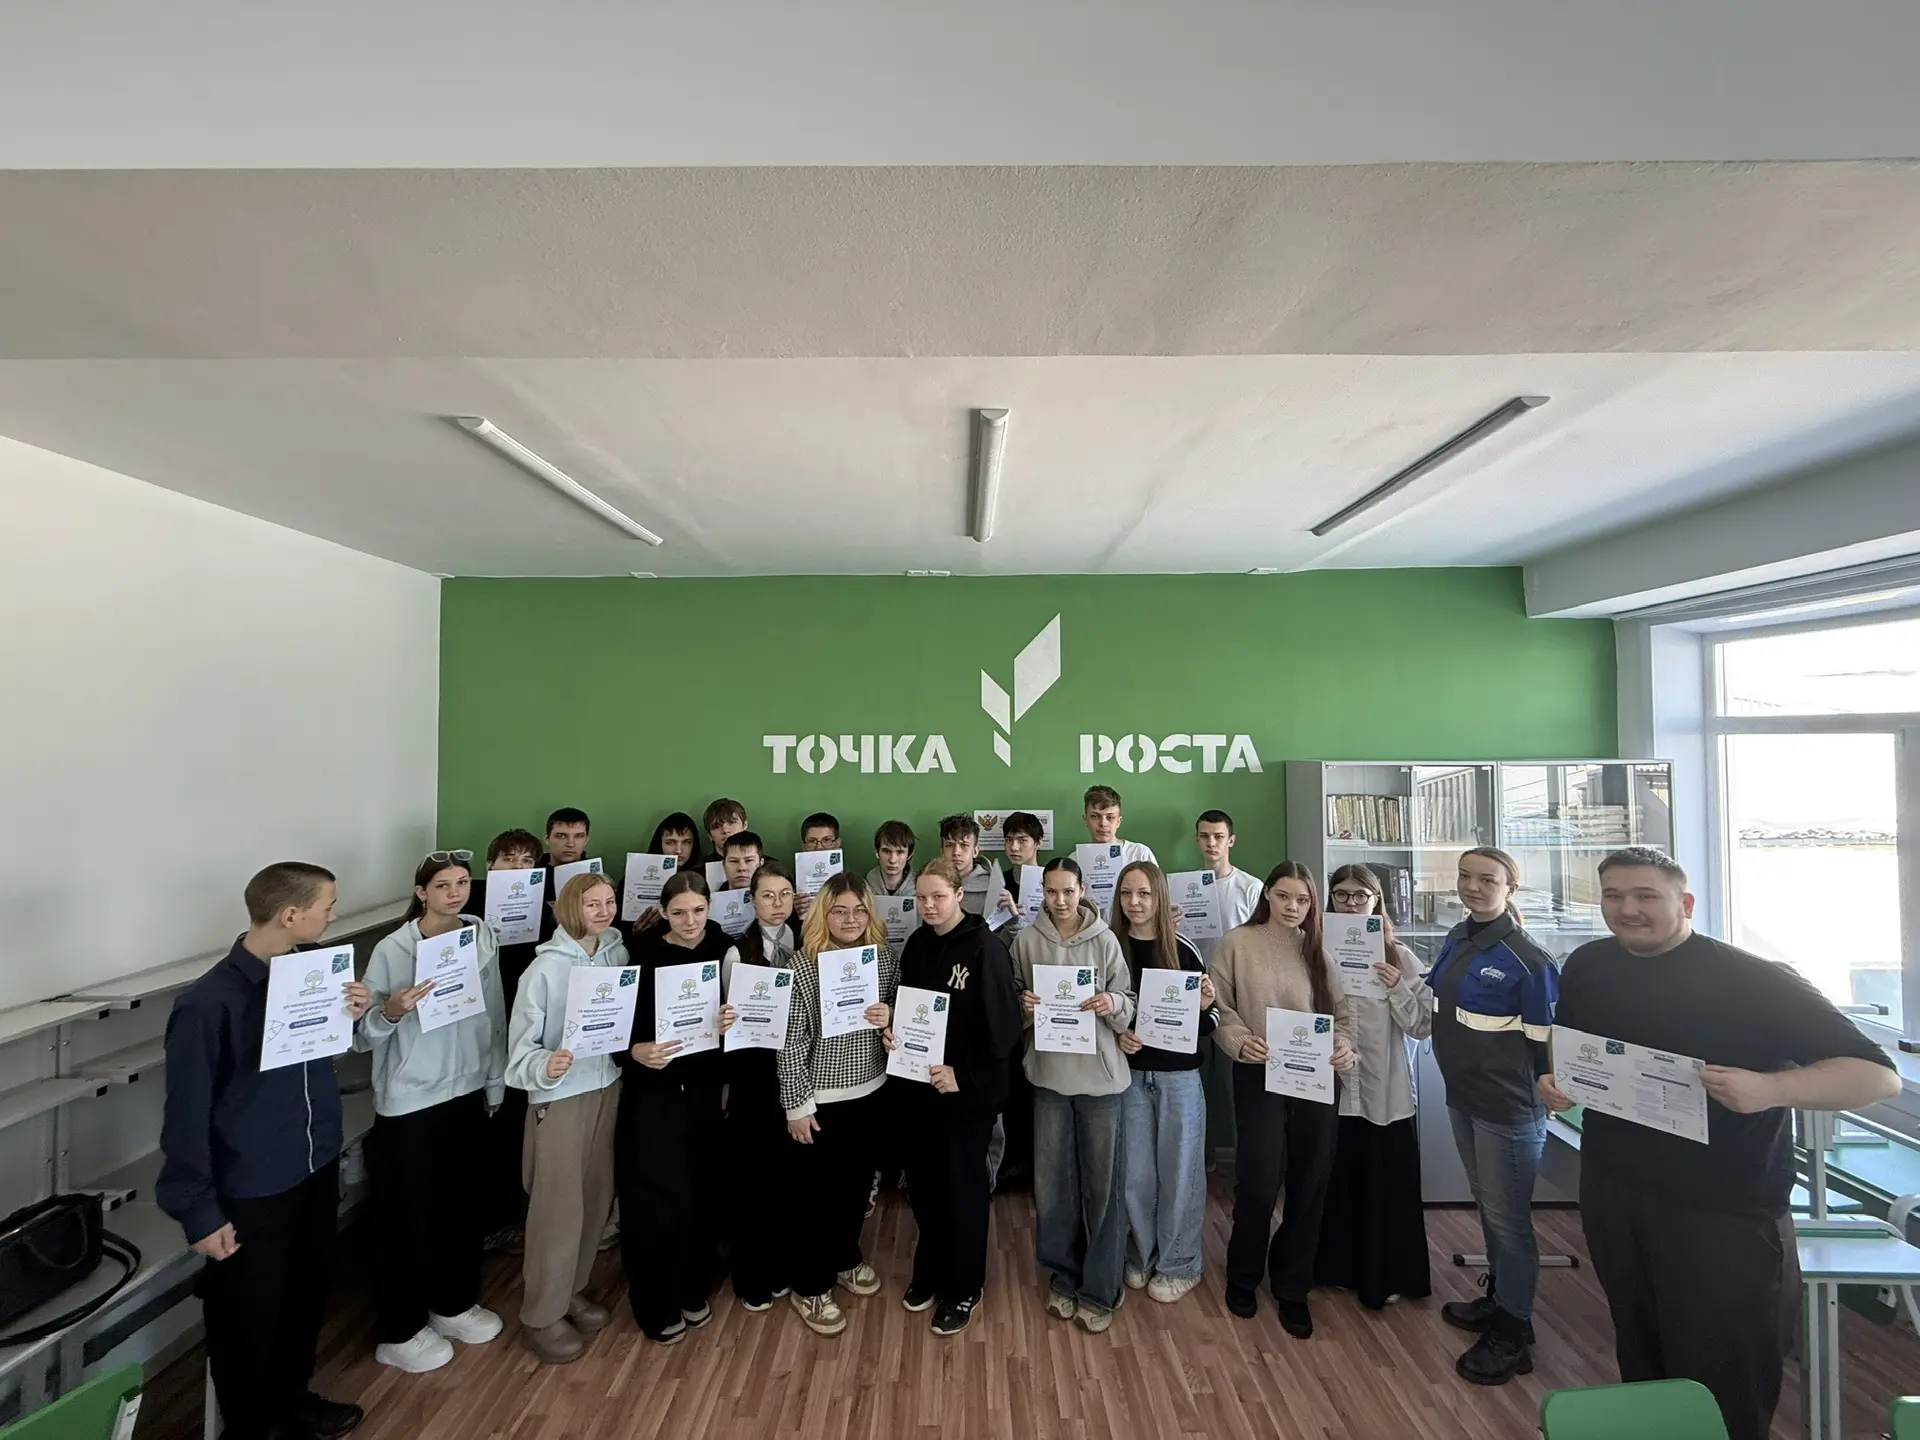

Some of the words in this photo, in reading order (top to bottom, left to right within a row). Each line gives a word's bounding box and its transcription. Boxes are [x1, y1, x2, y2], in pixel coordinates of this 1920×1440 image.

[763, 734, 957, 774] ТОЧКА
[1080, 733, 1264, 774] РОСТА
[947, 964, 970, 990] NY
